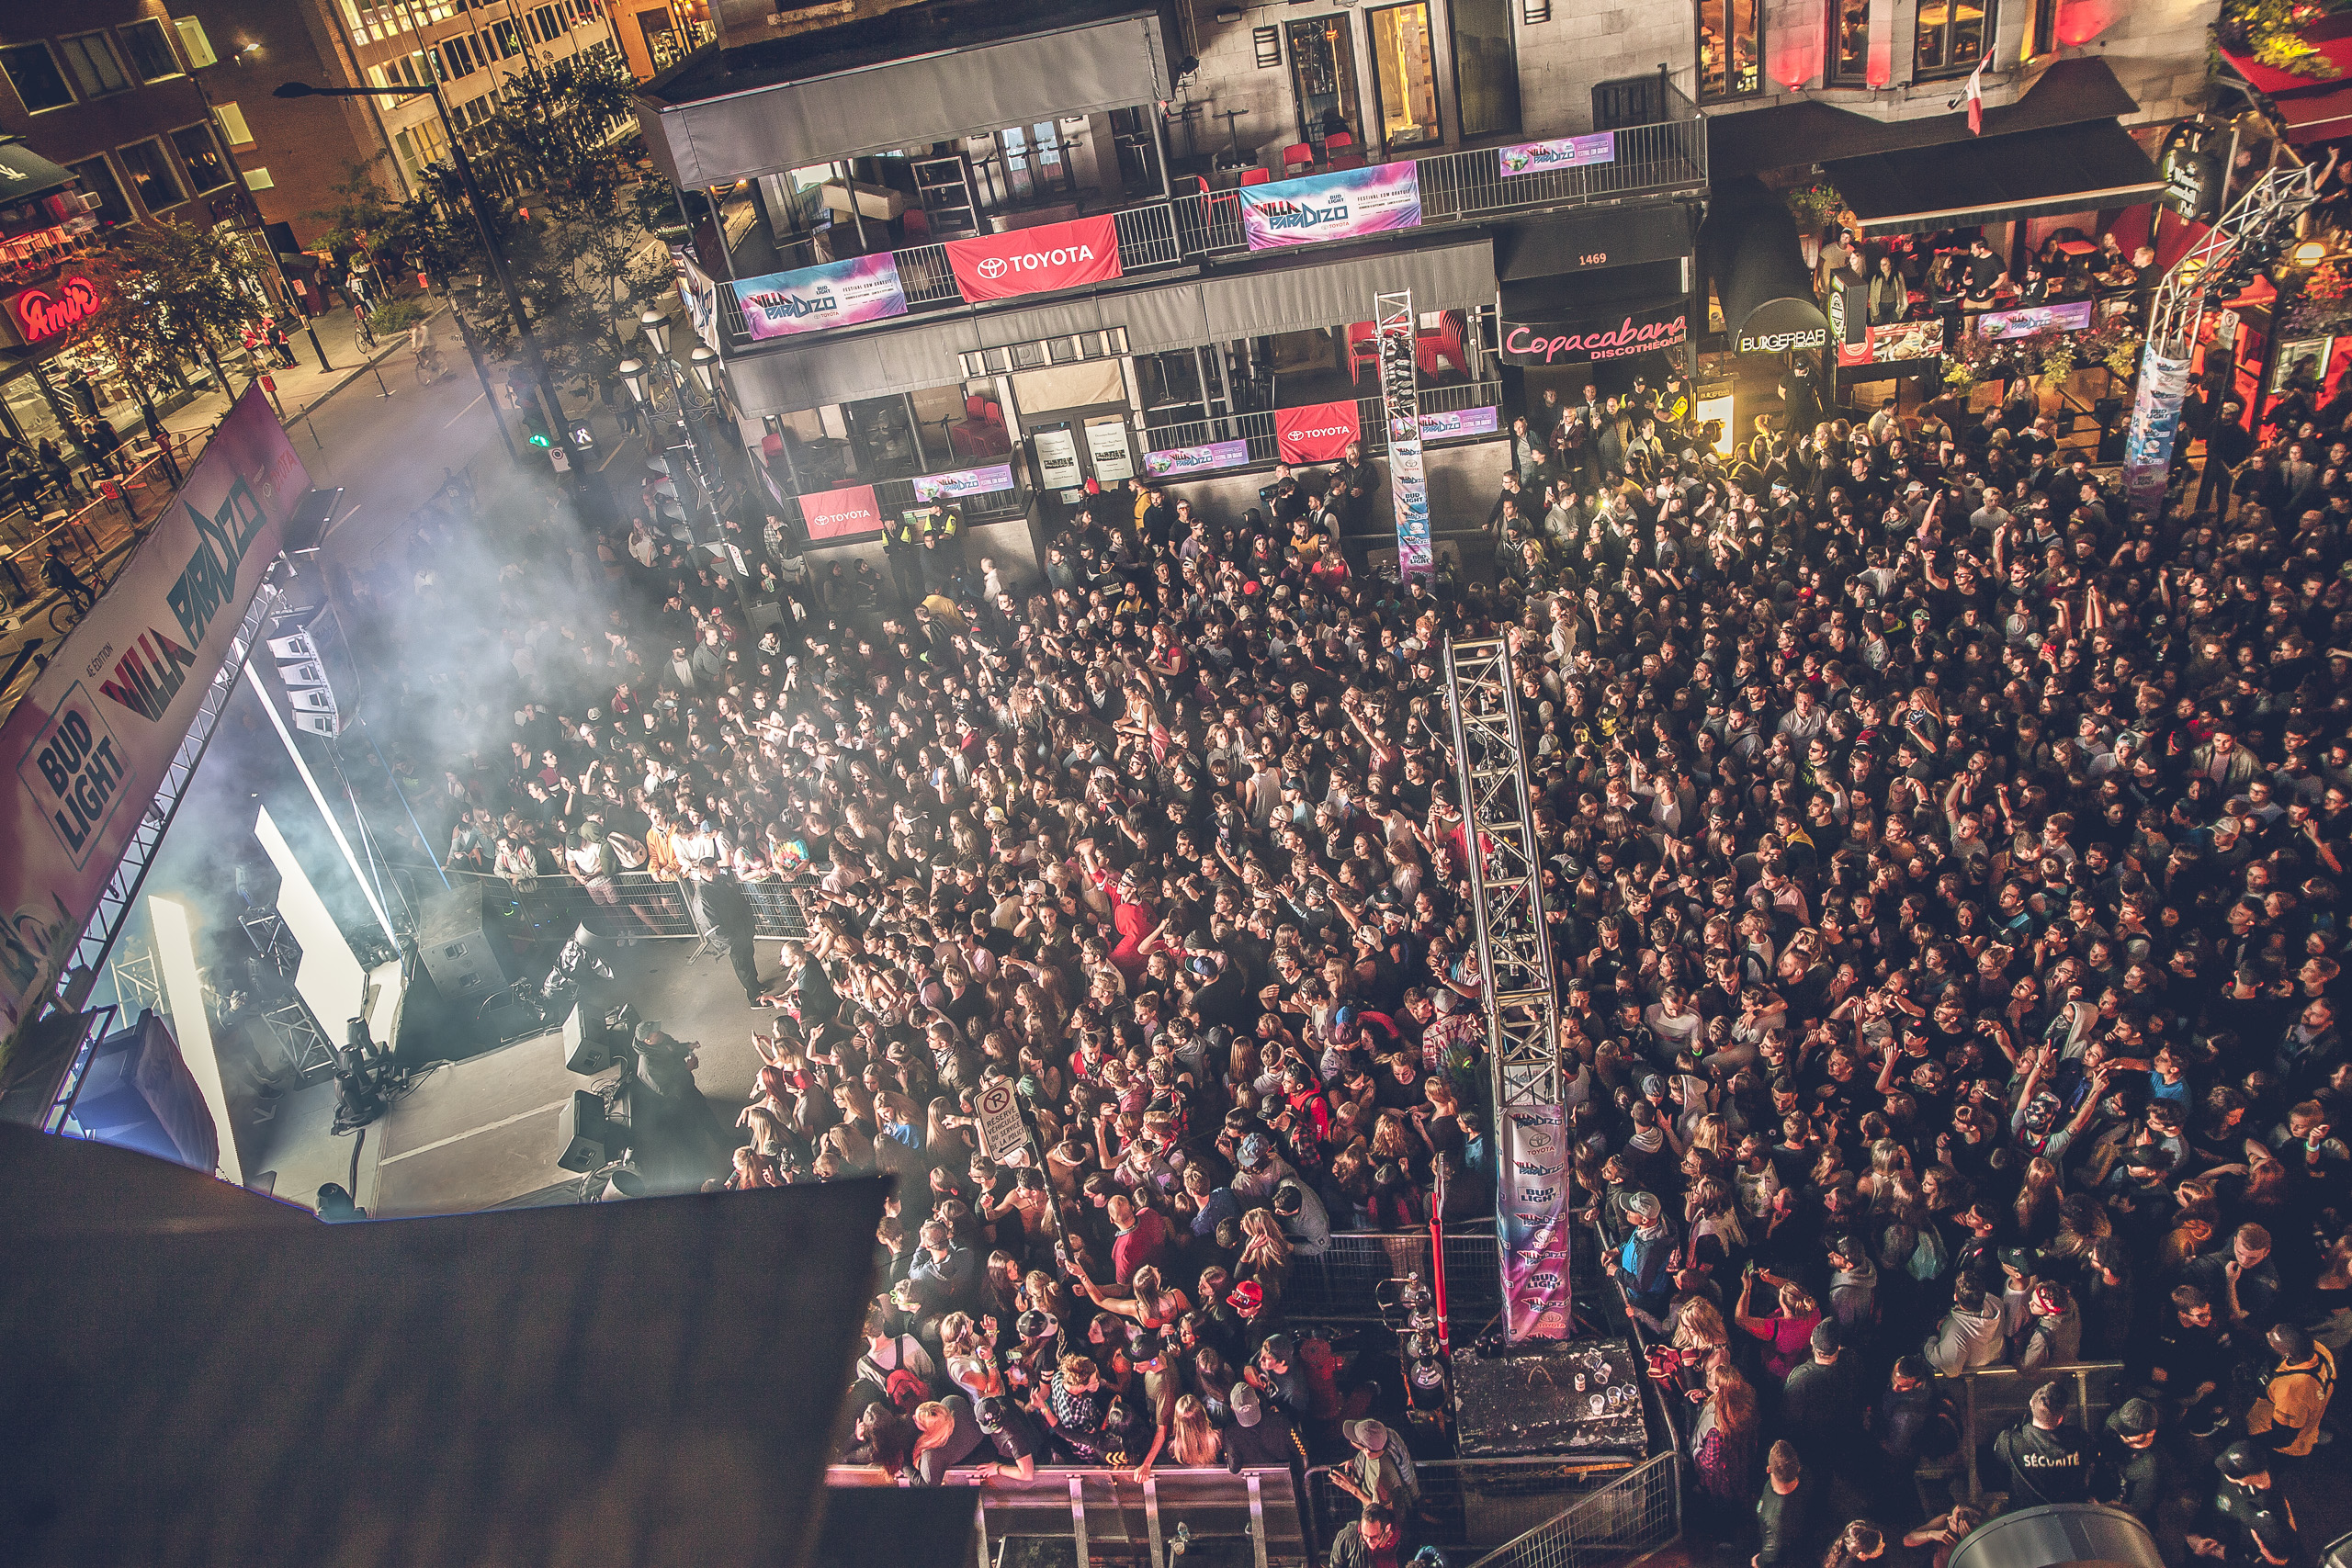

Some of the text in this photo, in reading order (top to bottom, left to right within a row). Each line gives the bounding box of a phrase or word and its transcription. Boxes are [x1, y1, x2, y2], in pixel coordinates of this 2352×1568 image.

[1534, 149, 1575, 164] PARADIZO
[1252, 200, 1302, 217] VILLA
[1269, 202, 1349, 230] PARADIZO
[1009, 244, 1094, 272] TOYOTA
[1579, 253, 1607, 265] 1469
[20, 276, 98, 340] Amir
[749, 292, 793, 308] VILLA
[764, 294, 837, 320] PARADIZO
[1506, 315, 1688, 363] Copacabana
[1590, 333, 1685, 360] DISCOTHÈQUE
[1741, 328, 1826, 352] BURGERBAR
[1306, 425, 1350, 438] TOYOTA
[1423, 421, 1461, 433] PARADIZO
[1176, 455, 1213, 467] PARADIZO
[830, 509, 871, 522] TOYOTA
[98, 475, 267, 723] VILLA PARADIZO
[91, 641, 113, 671] ÉDITION
[37, 710, 92, 799] BUD
[54, 735, 124, 854] LIGHT
[987, 1105, 1016, 1128] RÉSERVÉ
[988, 1113, 1020, 1134] VÉHICULES
[1508, 1112, 1535, 1122] VILLA
[1517, 1114, 1563, 1129] PARADIZO
[1000, 1121, 1021, 1137] SERVICE
[991, 1143, 999, 1151] DE
[1008, 1127, 1025, 1142] POLICE
[1527, 1145, 1555, 1156] TOYOTA
[1511, 1159, 1540, 1169] VILLA
[1519, 1163, 1564, 1176] PARADIZO
[1526, 1187, 1554, 1196] BUD
[2023, 1450, 2080, 1468] SÉCURITÉ
